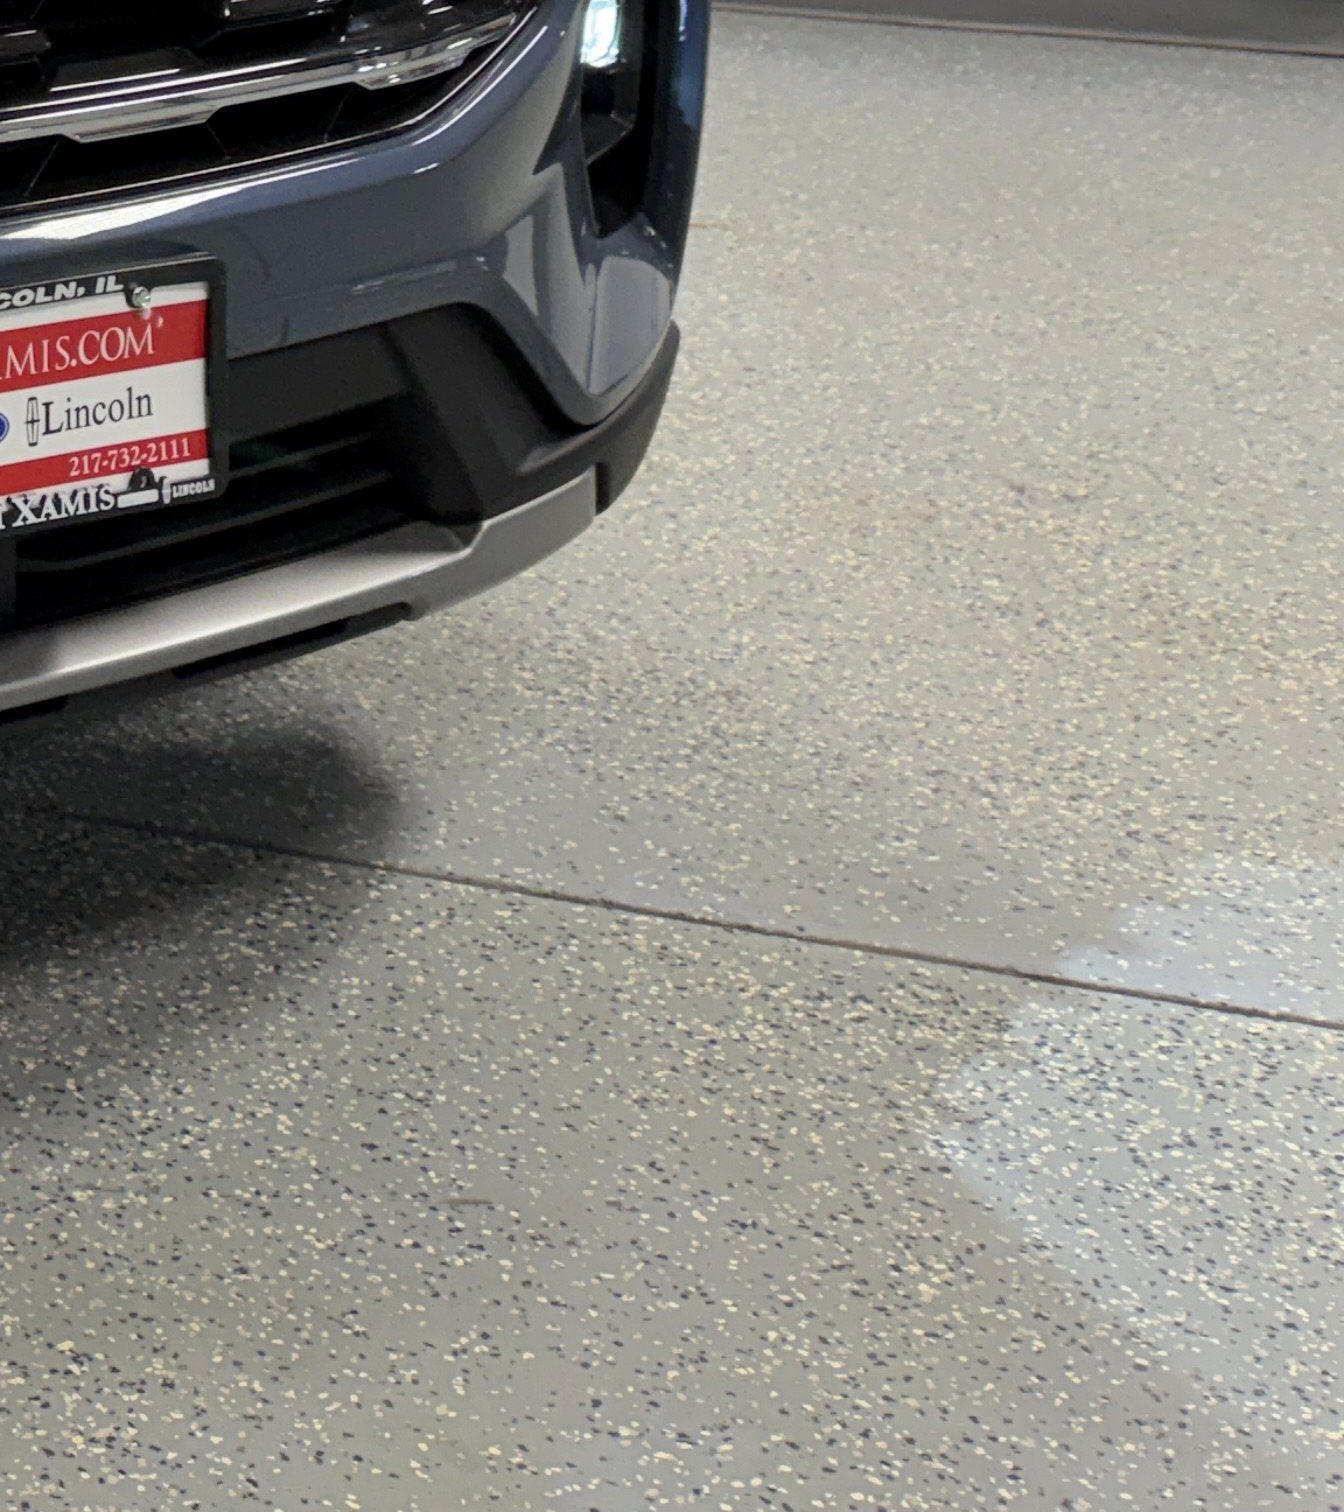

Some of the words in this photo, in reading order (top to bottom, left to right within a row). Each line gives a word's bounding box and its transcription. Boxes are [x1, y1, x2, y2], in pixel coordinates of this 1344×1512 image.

[95, 275, 124, 293] IL
[42, 387, 153, 436] Lincoln
[69, 438, 192, 477] 217-732-2111
[11, 487, 116, 529] XAMIS
